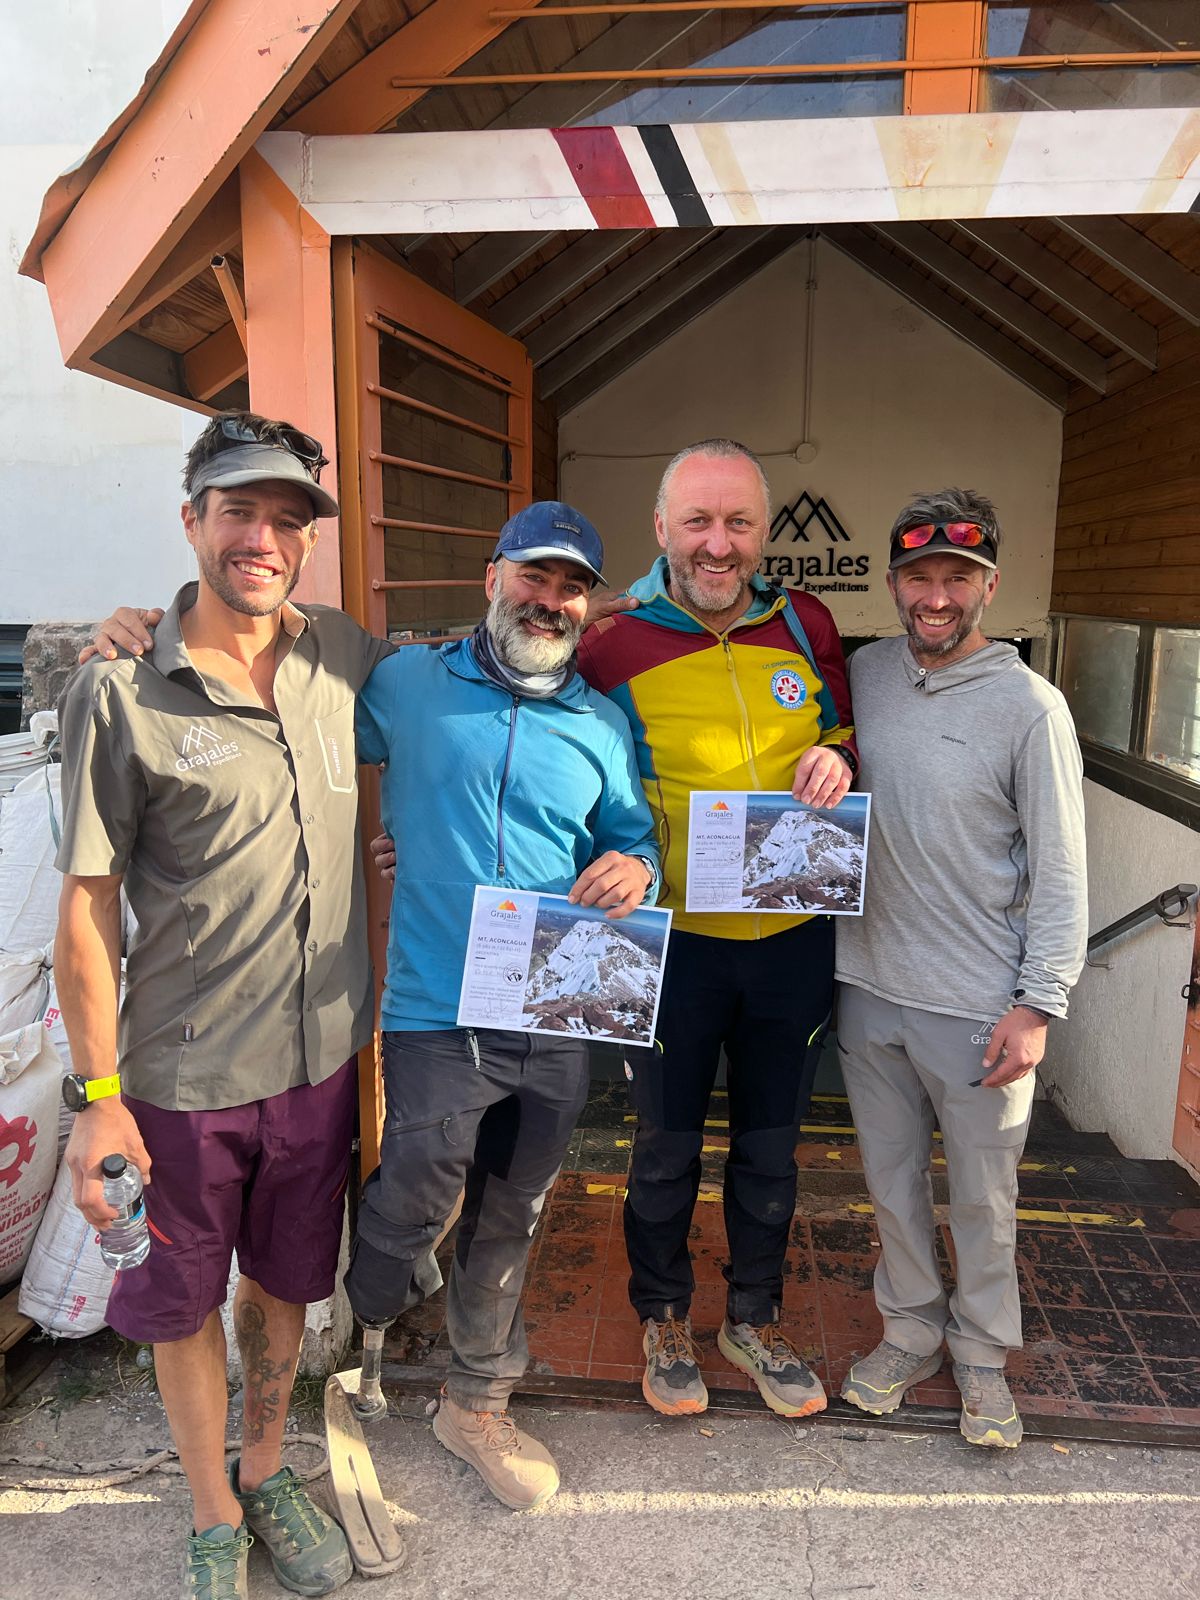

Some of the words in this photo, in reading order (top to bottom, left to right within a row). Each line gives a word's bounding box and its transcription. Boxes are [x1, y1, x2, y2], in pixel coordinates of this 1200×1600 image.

[757, 547, 870, 586] rajales
[803, 581, 870, 595] Expeditions
[175, 740, 239, 772] Grajales
[705, 810, 734, 820] Grajales
[490, 909, 522, 922] Grajales
[489, 936, 527, 947] ACONCAGUA
